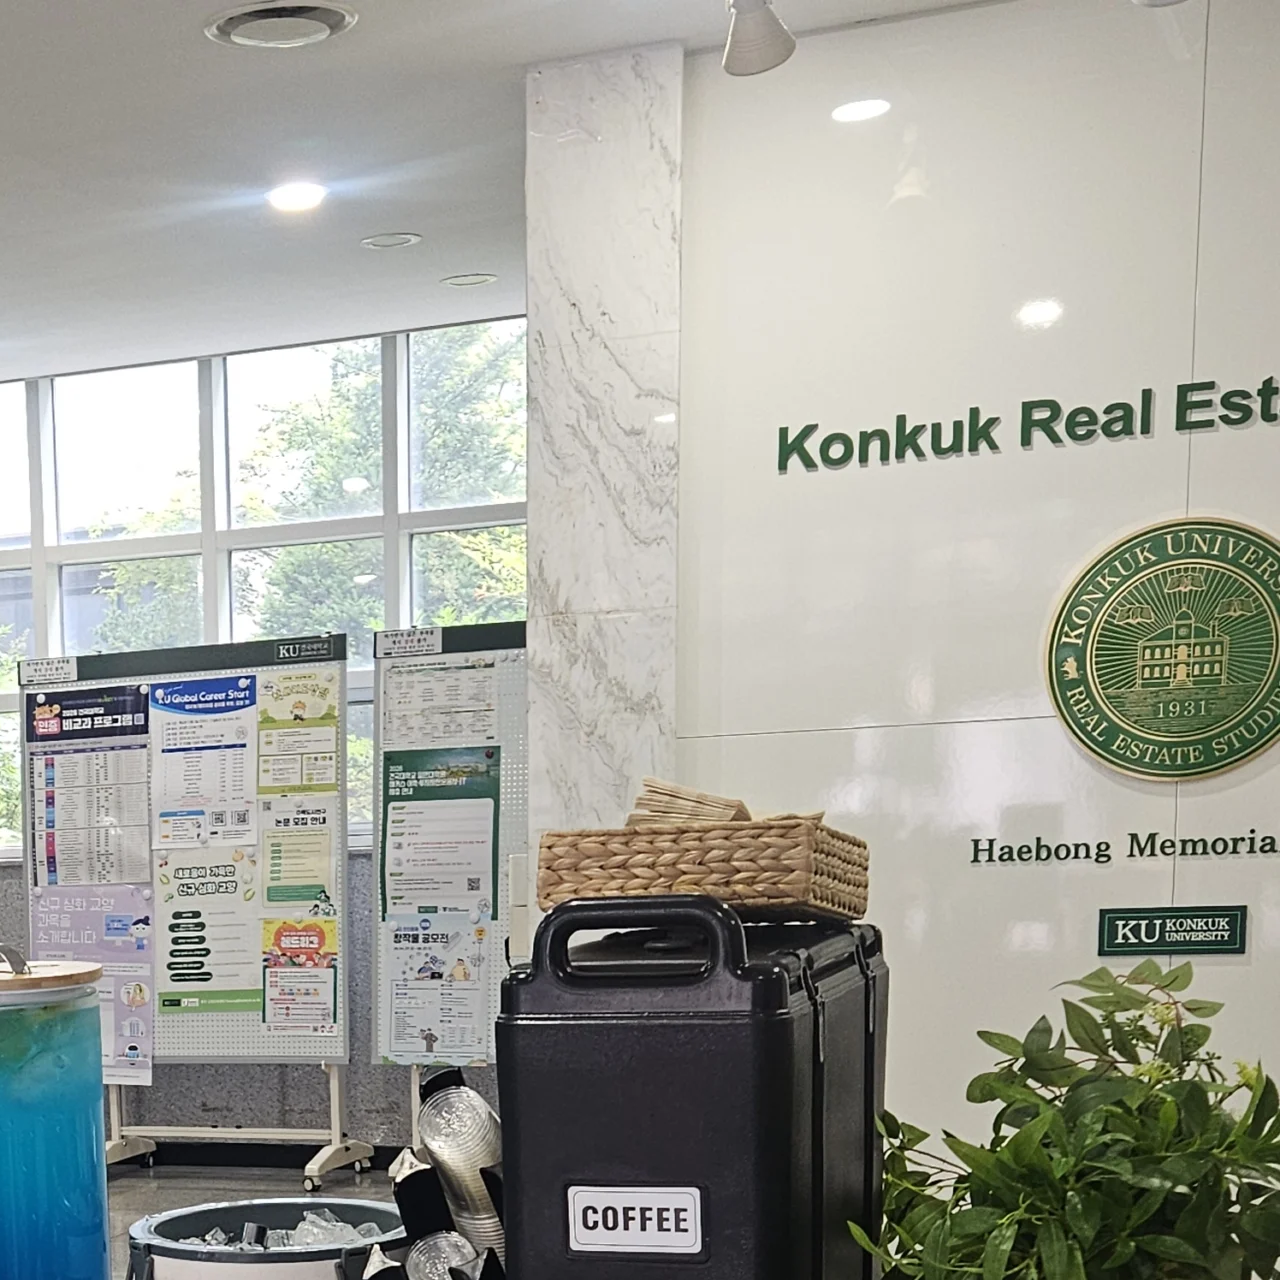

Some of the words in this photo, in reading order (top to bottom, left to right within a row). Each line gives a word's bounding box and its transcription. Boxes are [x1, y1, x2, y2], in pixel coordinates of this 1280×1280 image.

[777, 407, 1000, 473] Konkuk
[1020, 388, 1153, 449] Real
[1174, 376, 1280, 432] Est
[1060, 542, 1158, 647] KONKUK
[1163, 531, 1280, 601] UNIVERS
[279, 644, 300, 658] KU
[172, 694, 198, 703] Global
[199, 691, 226, 701] Career
[228, 689, 250, 699] Start
[1157, 700, 1207, 718] 1931
[62, 717, 92, 731] 비교과
[93, 713, 133, 729] 프로그램
[1066, 685, 1107, 742] REAL
[1110, 733, 1205, 766] ESTATE
[310, 816, 327, 826] 안내
[970, 837, 1112, 864] Haebong
[1127, 828, 1280, 859] Memoria
[177, 883, 197, 896] 신규
[217, 880, 238, 894] 교양
[39, 897, 61, 911] 신규
[63, 897, 87, 912] 심화
[89, 897, 115, 912] 교양
[1114, 919, 1162, 944] KU
[1165, 917, 1230, 931] KONKUK
[421, 932, 449, 944] 공모전
[1165, 929, 1230, 942] UNIVERSITY
[581, 1204, 690, 1234] COFFEE
